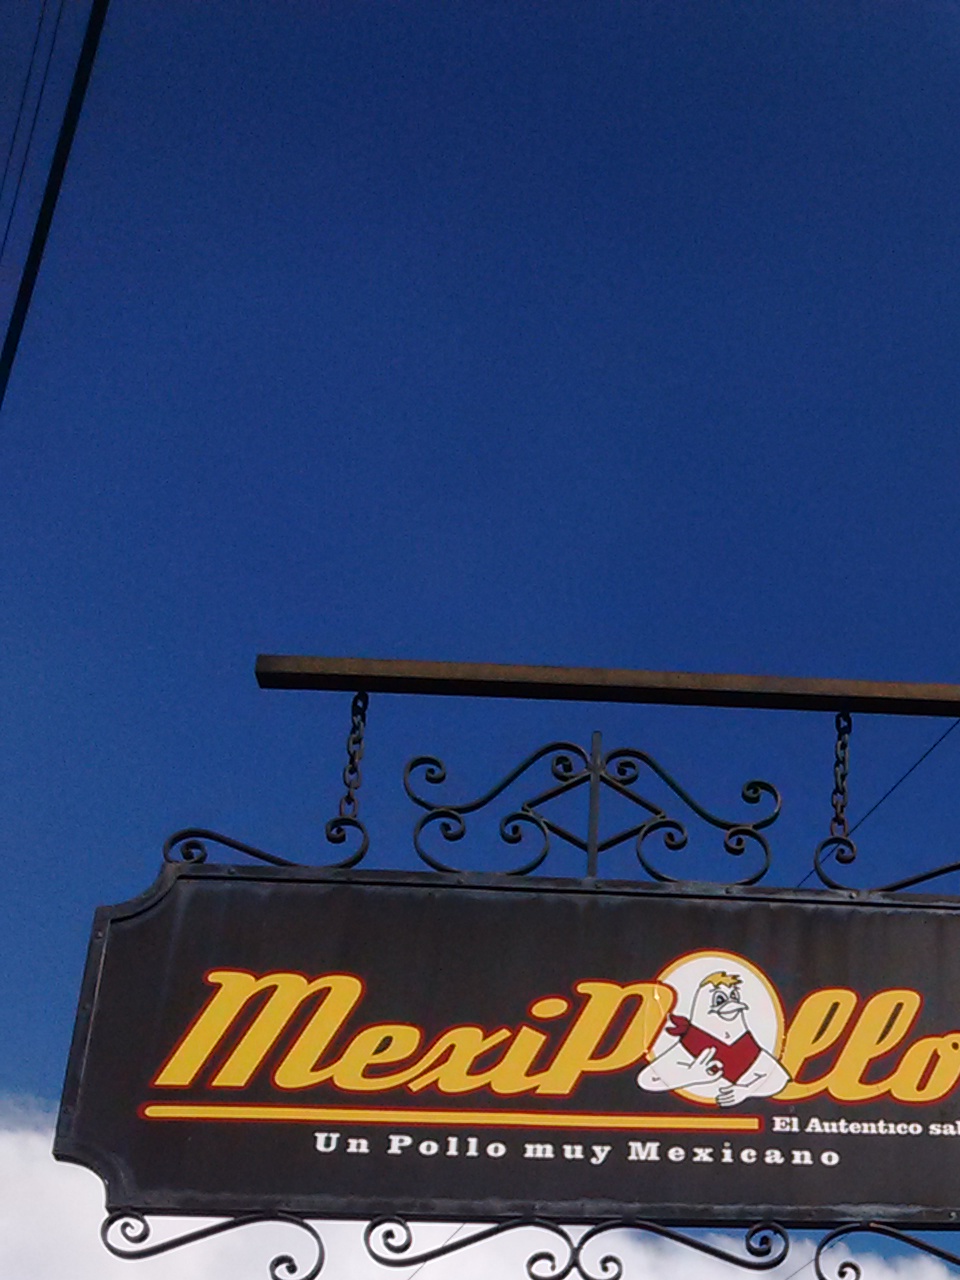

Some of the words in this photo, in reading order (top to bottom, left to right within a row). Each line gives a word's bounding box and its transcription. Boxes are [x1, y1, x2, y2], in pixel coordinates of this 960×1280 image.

[771, 1115, 800, 1133] El
[804, 1117, 923, 1136] Autentico
[314, 1131, 371, 1155] Un
[386, 1133, 507, 1158] Pollo
[523, 1141, 612, 1165] muy
[627, 1140, 841, 1168] Mexicano
